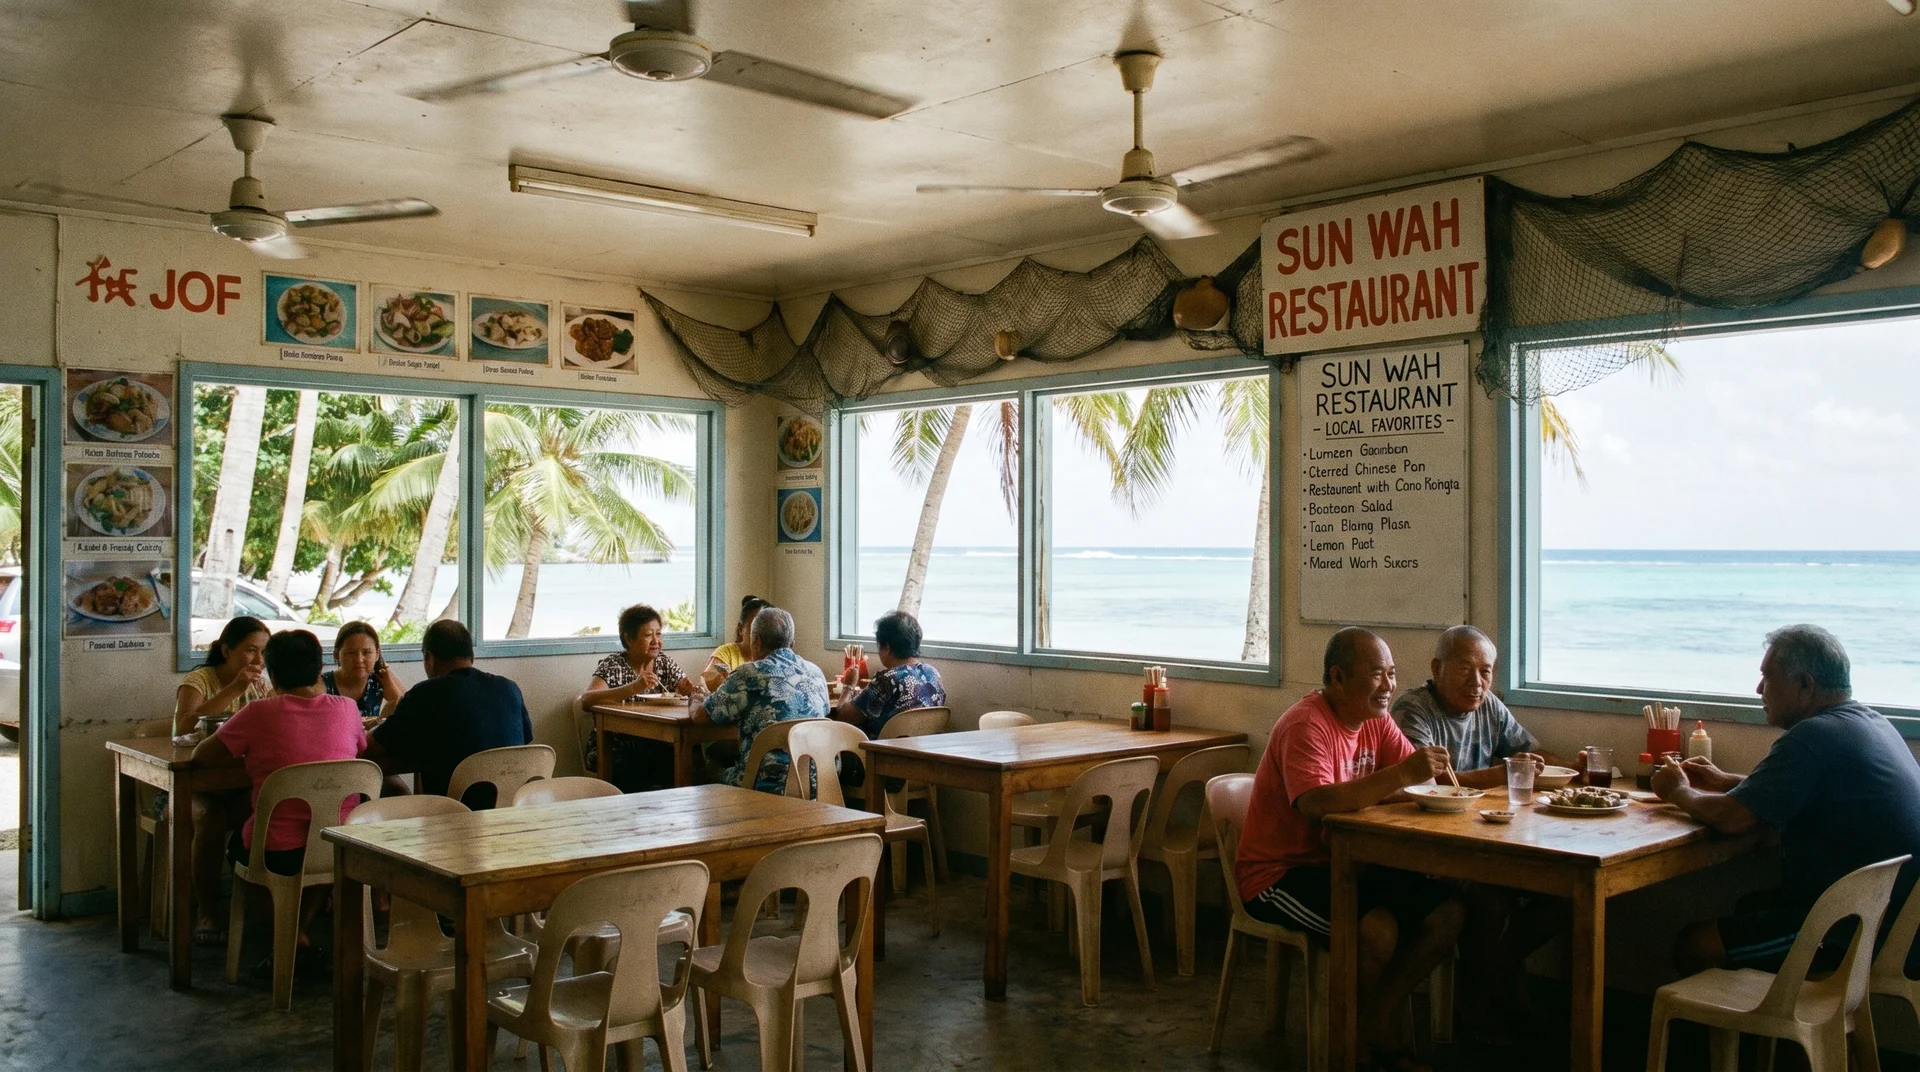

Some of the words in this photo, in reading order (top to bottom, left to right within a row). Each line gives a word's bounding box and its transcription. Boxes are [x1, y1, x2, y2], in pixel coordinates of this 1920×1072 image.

[1277, 217, 1353, 276] SUN
[1367, 198, 1460, 260] WAH
[150, 269, 242, 316] JOF
[1268, 261, 1480, 340] RESTAURANT
[1321, 358, 1371, 389] SUN
[1383, 351, 1441, 383] WAH
[1316, 382, 1458, 417] RESTAURANT
[1326, 419, 1364, 436] LOCAL
[1371, 413, 1442, 433] FAVORITES
[1355, 462, 1397, 476] Chinese
[1366, 479, 1390, 494] with
[1361, 499, 1393, 513] Salad
[1310, 538, 1345, 551] Lemon
